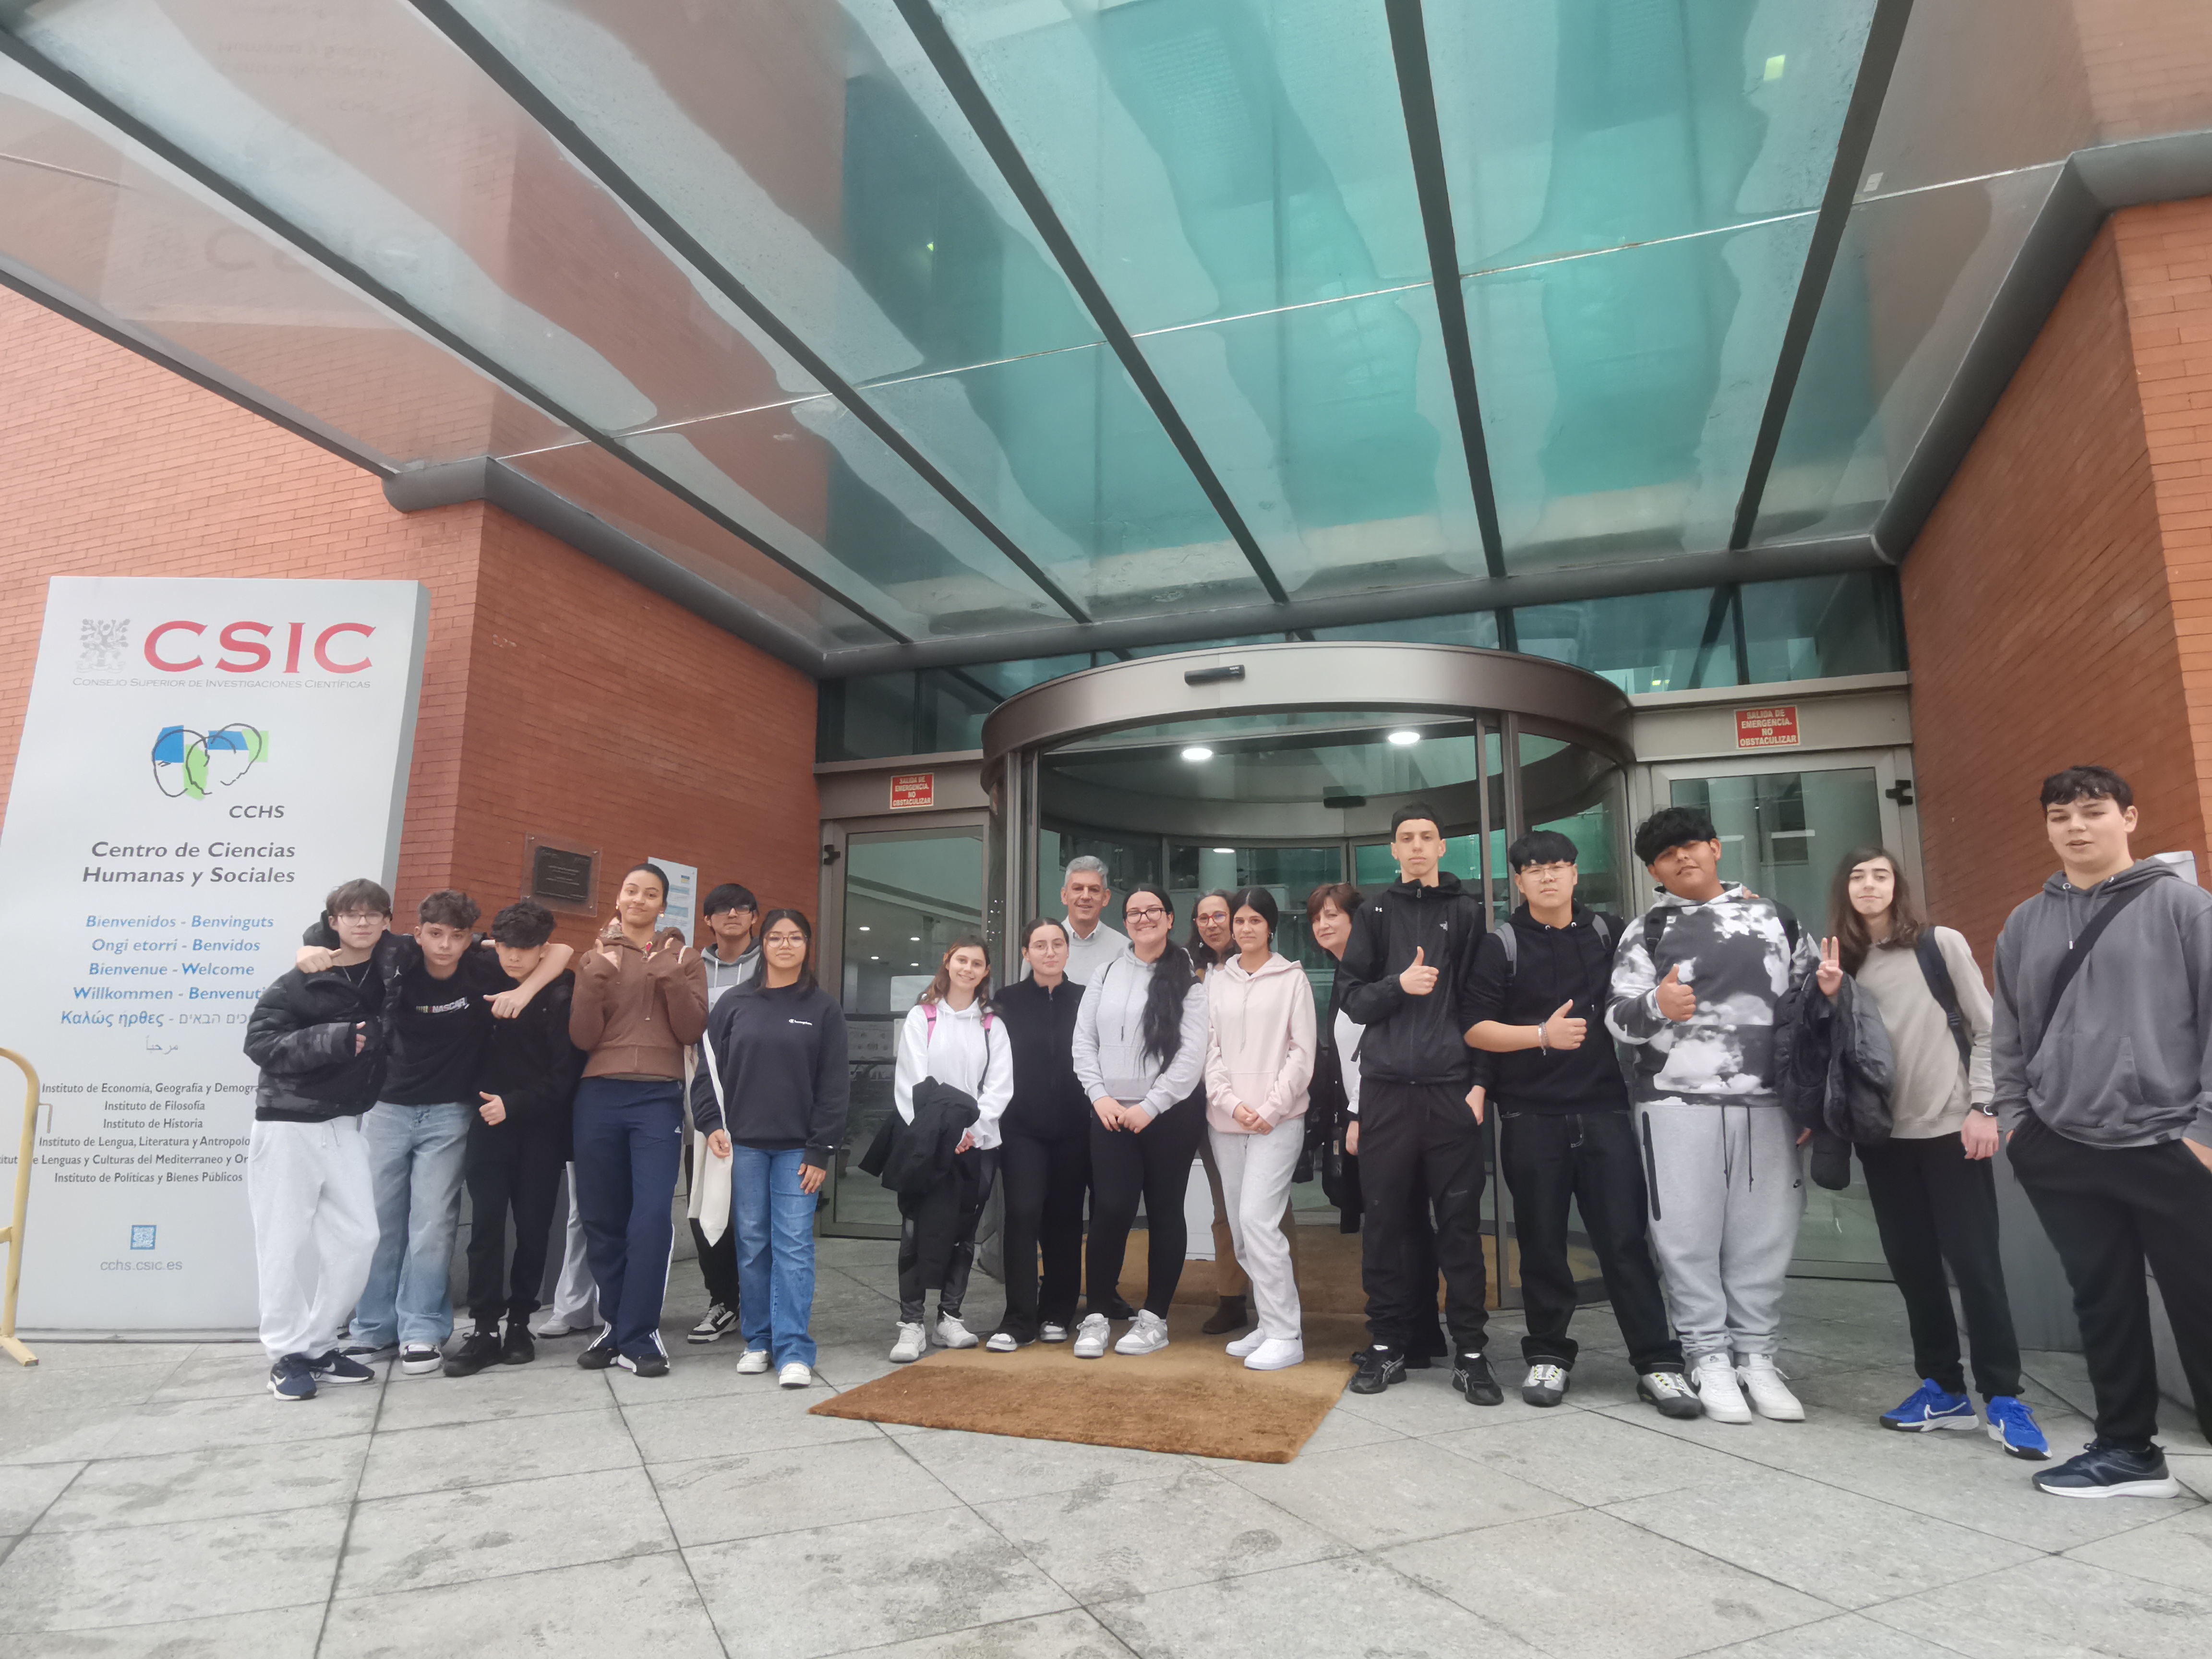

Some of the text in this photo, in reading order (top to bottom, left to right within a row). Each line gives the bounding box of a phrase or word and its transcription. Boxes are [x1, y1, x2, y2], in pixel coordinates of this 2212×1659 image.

[144, 621, 376, 673] CSIC
[1747, 710, 1773, 719] SALIDA
[1762, 728, 1773, 736] NO
[1740, 735, 1797, 746] OBSTACULIZAR
[893, 797, 931, 806] OBSTACULIZAR
[229, 805, 285, 818] CCHS
[92, 842, 295, 857] Centro de Ciencias
[83, 867, 295, 887] Humanas y Sociales
[86, 915, 176, 927] Bienvenidos
[192, 915, 273, 931] Benvinguts
[92, 939, 129, 955] Ongi
[133, 938, 178, 951] etorri
[192, 939, 260, 951] Benvidos
[89, 963, 167, 975] Bienvenue
[182, 963, 254, 975] Welcome
[73, 987, 173, 999] Willkommen
[189, 987, 265, 999] Benvenut
[61, 1010, 113, 1027] Καλώς
[179, 1014, 220, 1024] הבאים
[42, 1082, 254, 1095] Instituto de Economía, Geografía y Demogr
[105, 1100, 205, 1110] Instituto de Filosofía
[104, 1118, 203, 1128] Instituto de Historia
[39, 1136, 250, 1149] Instituto de Lengua, Literatura y Antropolo
[41, 1154, 81, 1167] Lenguas
[84, 1158, 89, 1167] y
[93, 1154, 134, 1164] Culturas
[138, 1154, 152, 1164] del
[226, 1157, 232, 1166] y
[235, 1154, 248, 1163] Or
[55, 1172, 242, 1185] Instituto de Políticas y Bienes Públicos
[100, 1259, 182, 1271] cchs.csic.es
